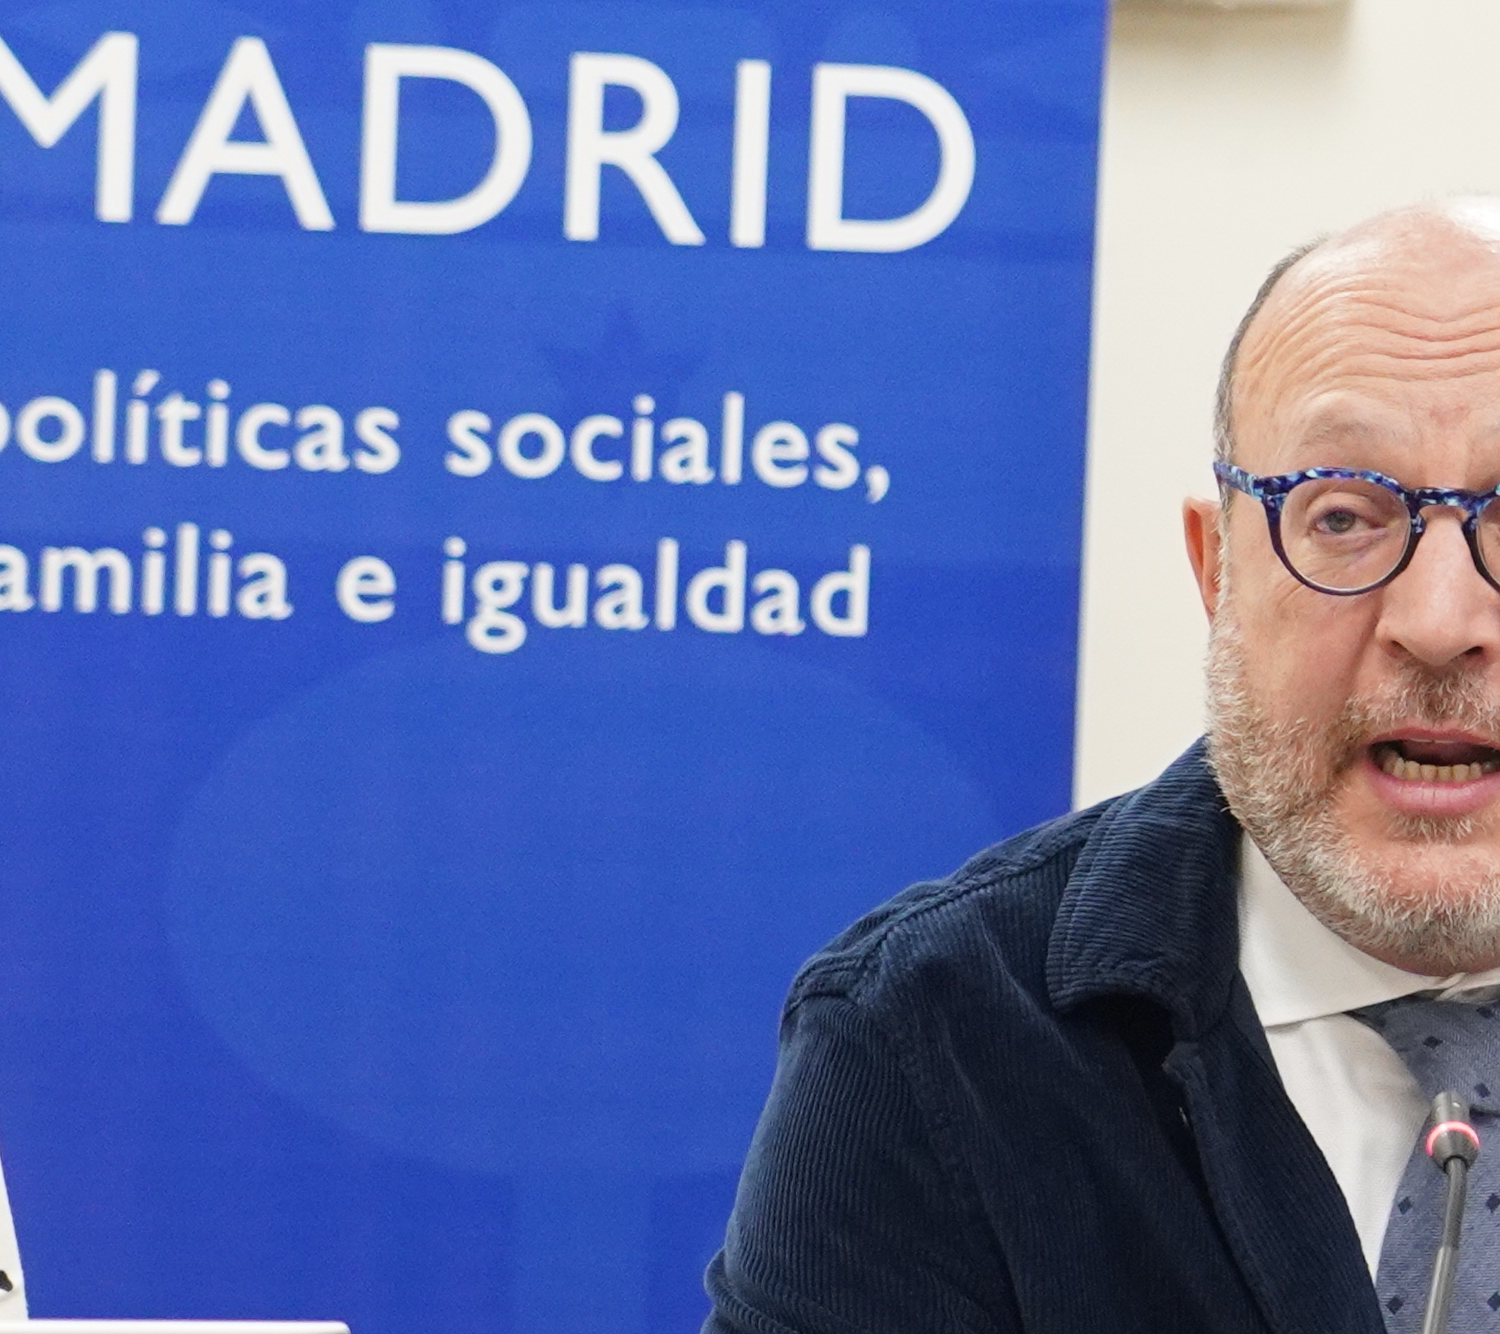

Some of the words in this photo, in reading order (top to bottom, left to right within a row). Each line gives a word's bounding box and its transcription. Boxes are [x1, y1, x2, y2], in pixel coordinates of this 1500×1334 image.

[446, 391, 890, 503] sociales,
[336, 555, 398, 623] e
[442, 536, 871, 655] igualdad
